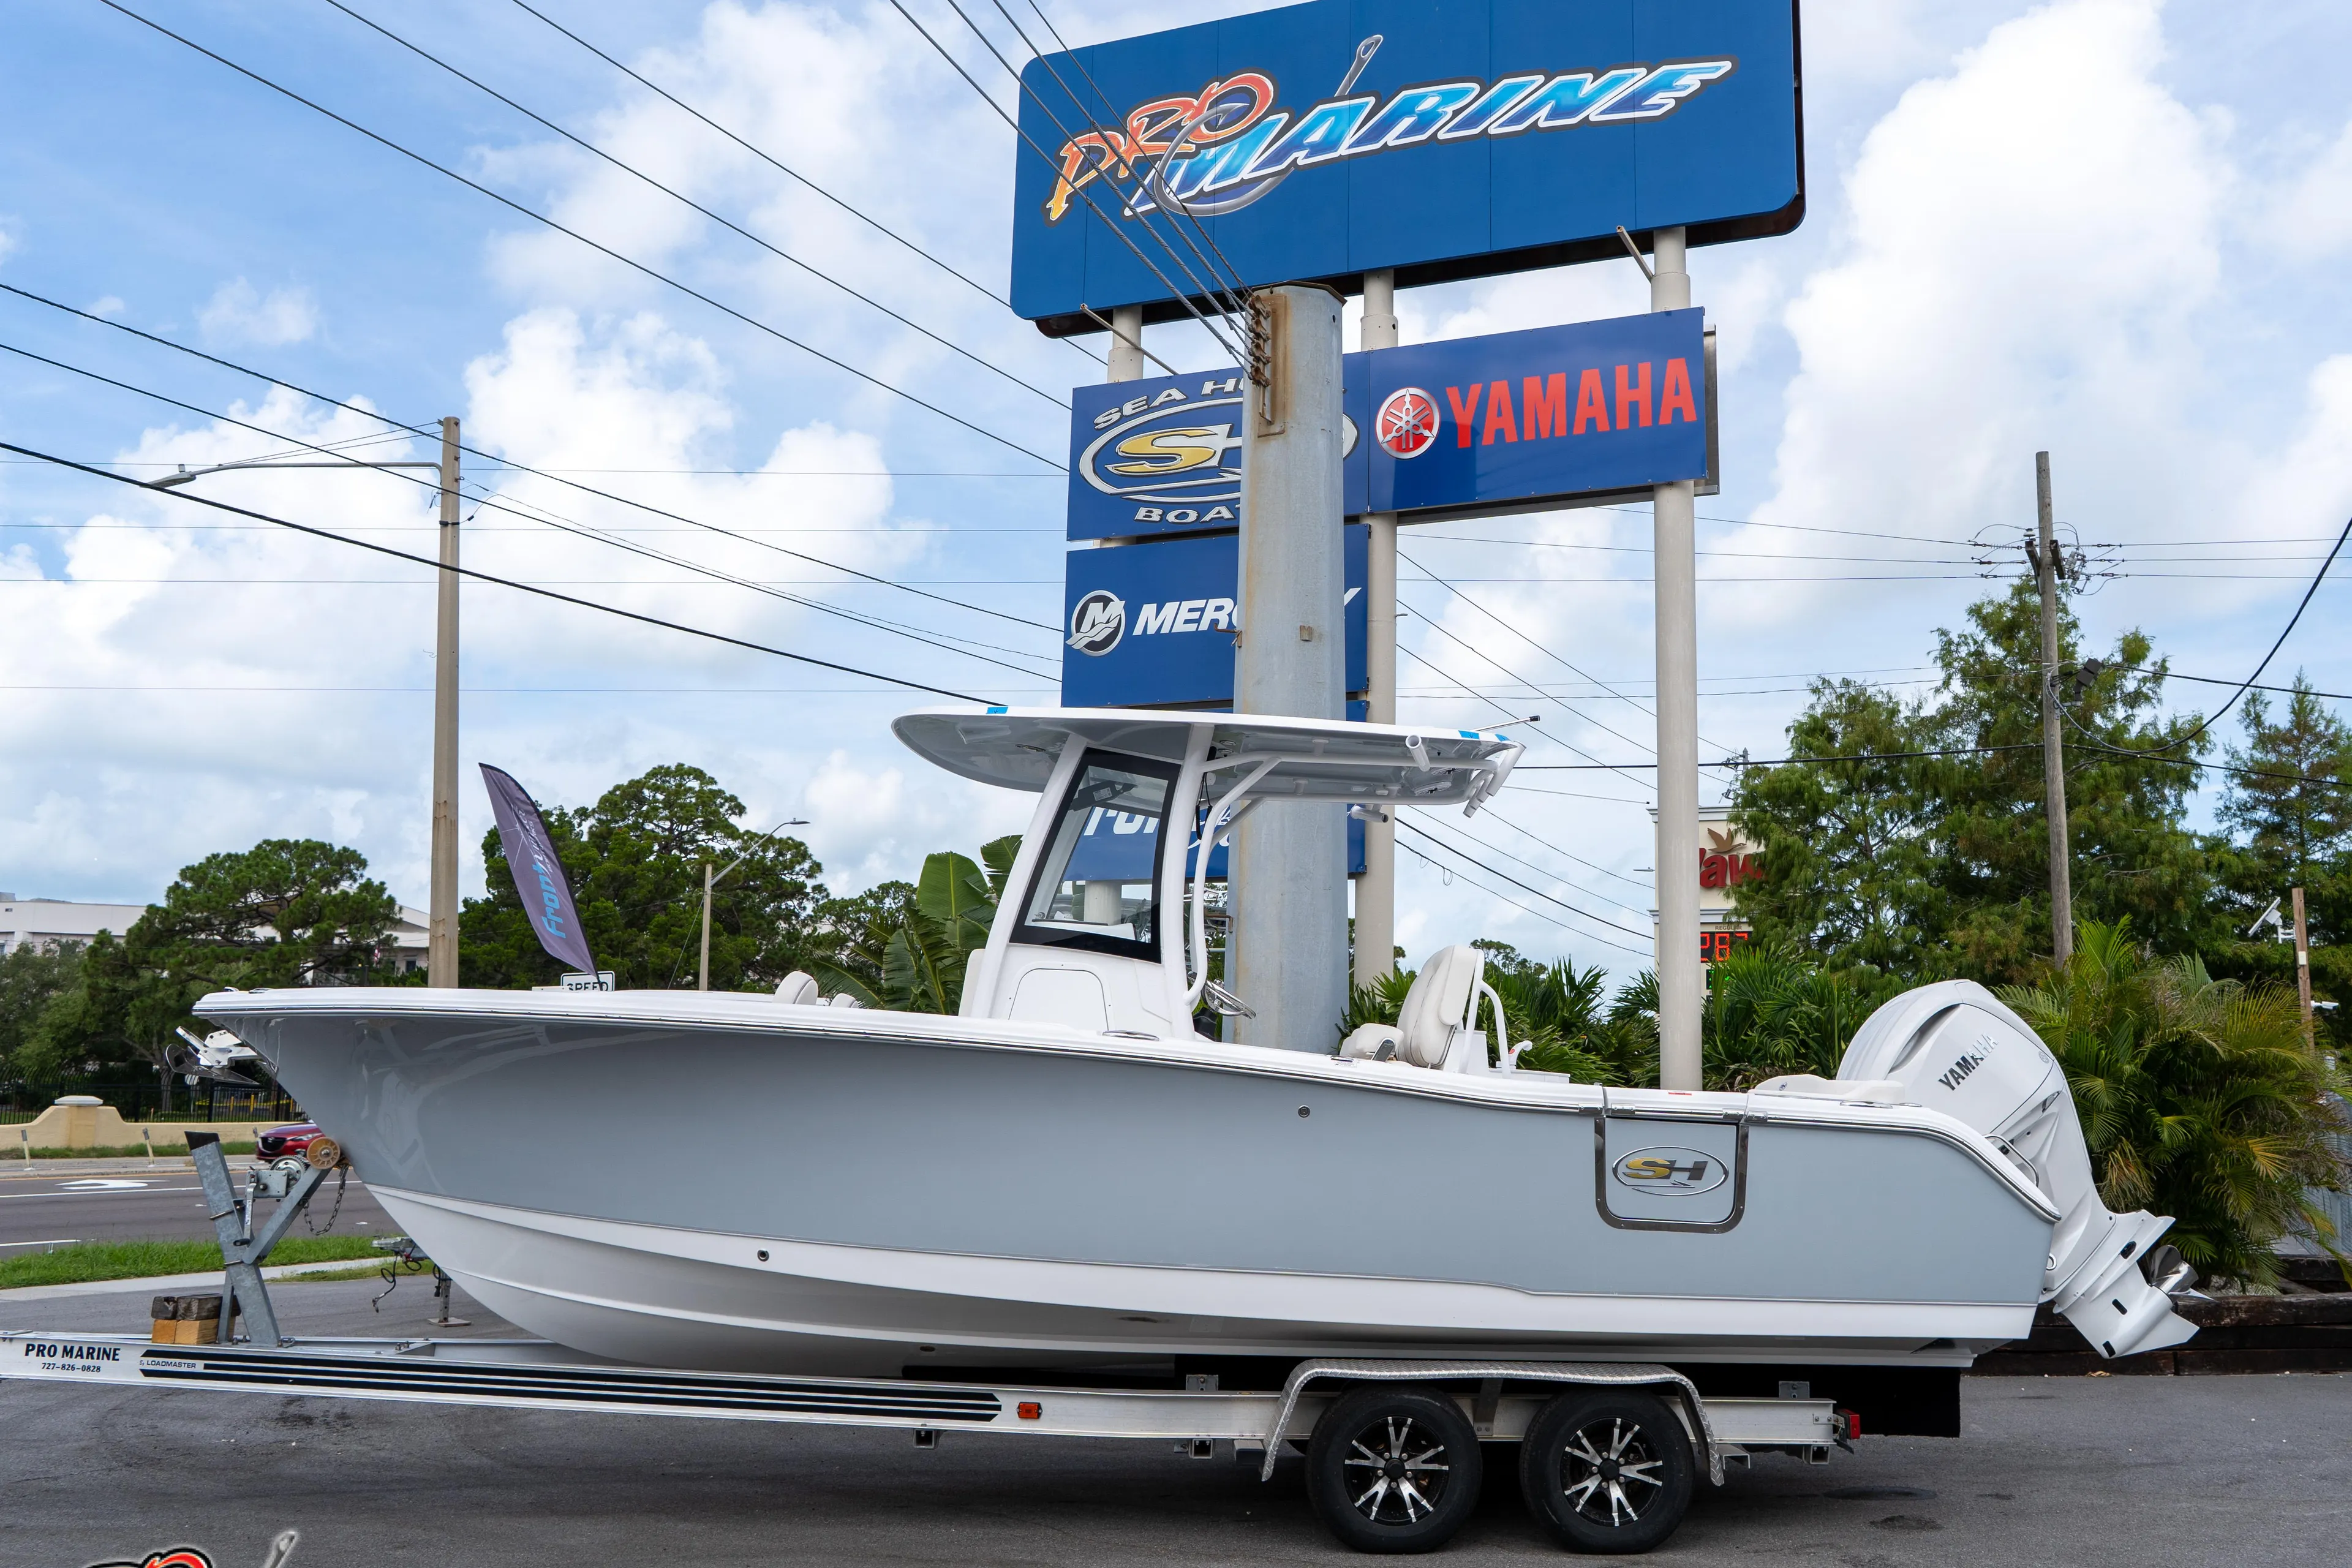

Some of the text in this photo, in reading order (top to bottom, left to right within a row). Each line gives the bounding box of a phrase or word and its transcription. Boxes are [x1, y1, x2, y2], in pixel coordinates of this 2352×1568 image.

[1045, 73, 1275, 222] PRO
[1123, 60, 1733, 218] MARINE
[1093, 388, 1187, 429] SEA
[1446, 357, 1697, 448] YAMAHA
[532, 862, 566, 938] Front
[1938, 1032, 1999, 1091] YAMAHA
[1622, 1157, 1708, 1180] SH
[24, 1343, 121, 1361] PRO MARINE
[41, 1362, 101, 1373] 727-826-0828
